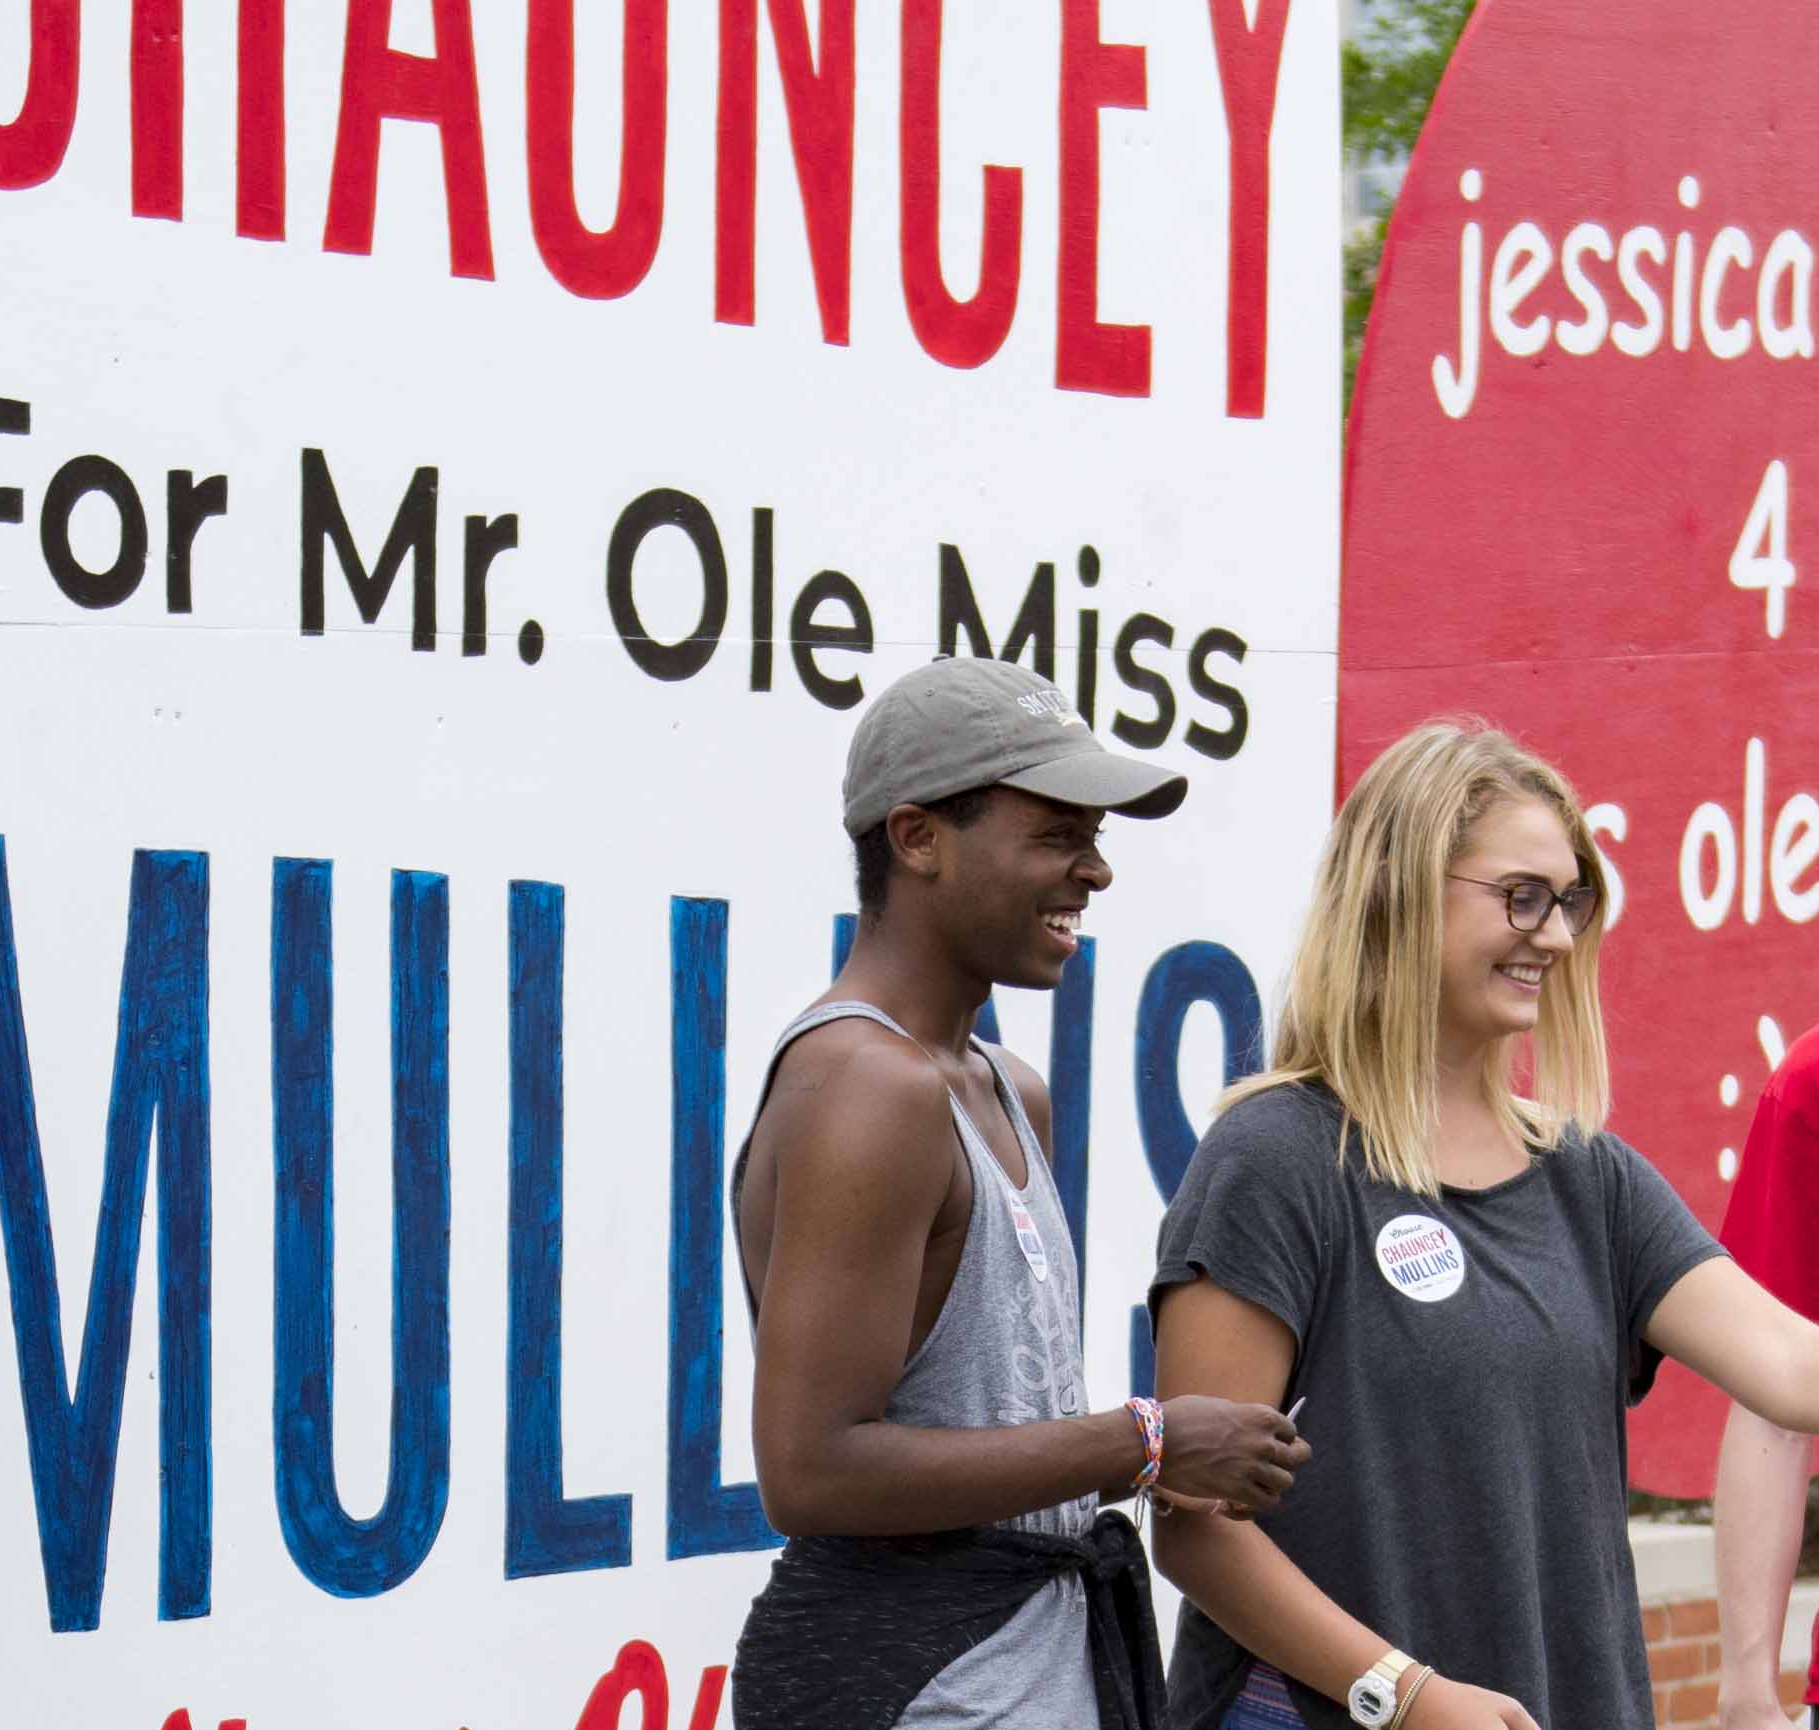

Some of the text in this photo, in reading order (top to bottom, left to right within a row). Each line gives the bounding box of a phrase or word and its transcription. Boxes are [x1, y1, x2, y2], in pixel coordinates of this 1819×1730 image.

[1431, 168, 1814, 418] jessica
[300, 447, 543, 667] Mr.
[605, 487, 874, 711] Ole
[1728, 459, 1796, 639] 4
[1382, 1228, 1447, 1264] CHAUNCEY
[1391, 1249, 1459, 1286] MULLINS
